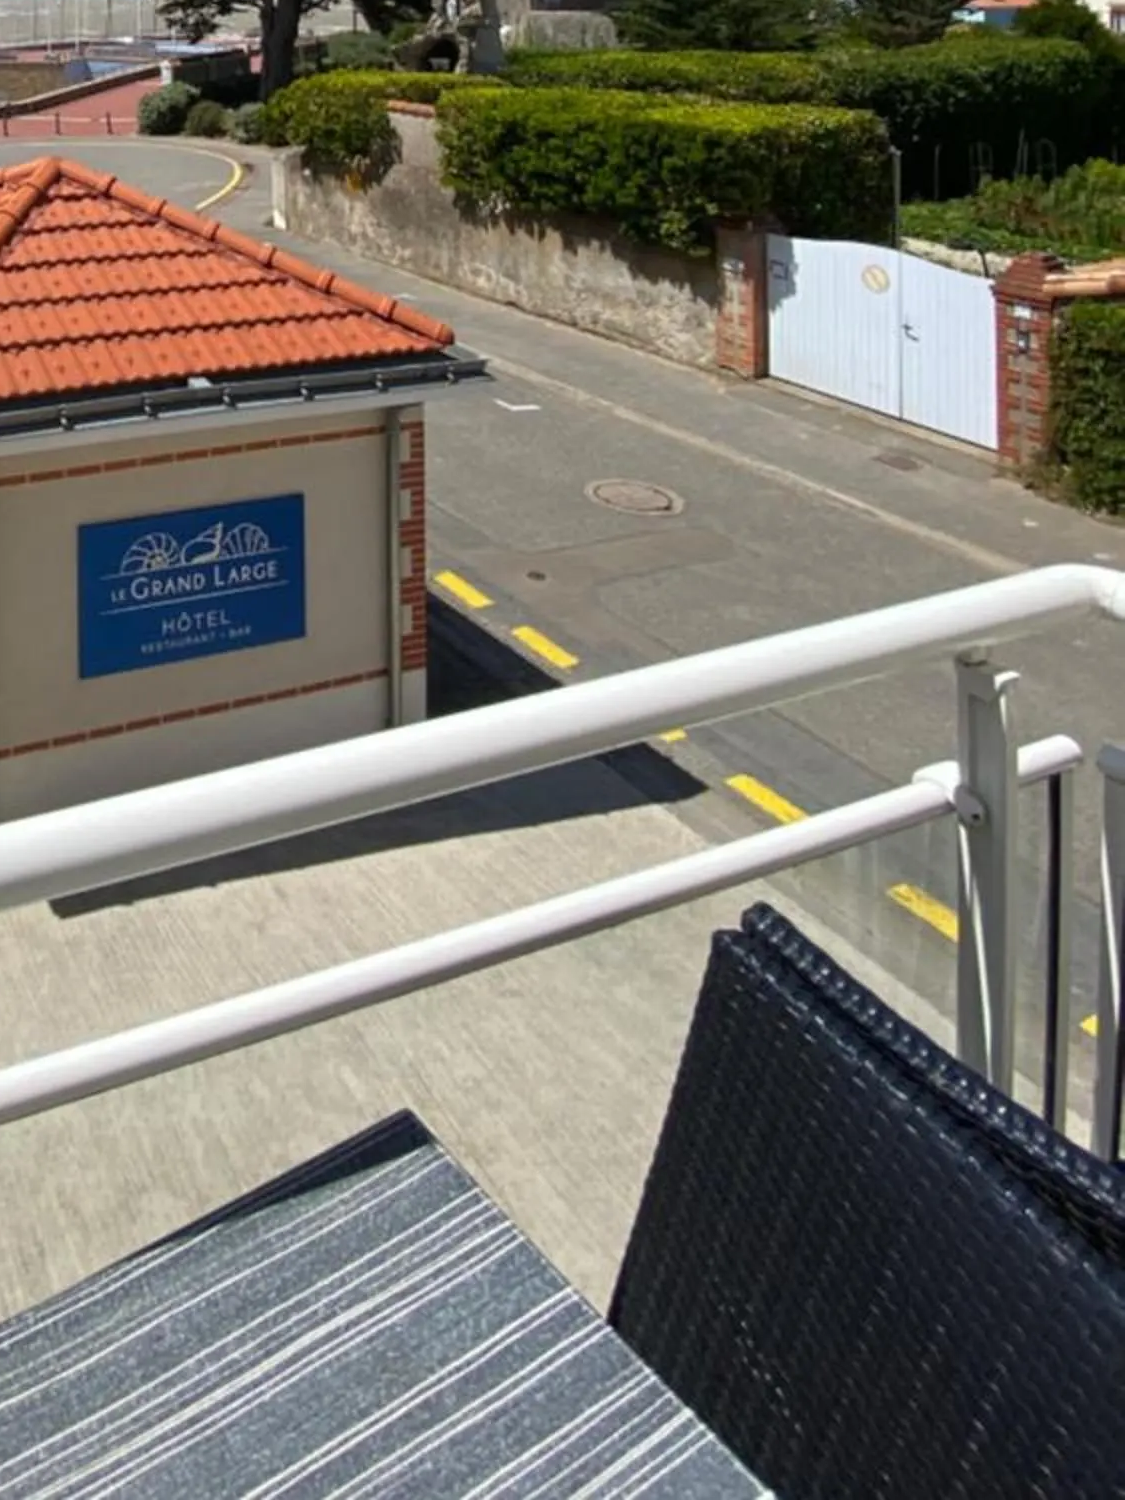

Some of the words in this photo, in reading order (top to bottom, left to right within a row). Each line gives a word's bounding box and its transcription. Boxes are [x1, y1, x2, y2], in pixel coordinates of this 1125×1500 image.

[111, 588, 125, 603] LE
[130, 572, 205, 601] GRAND
[214, 560, 278, 587] LARGE
[162, 609, 231, 636] HÔTEL
